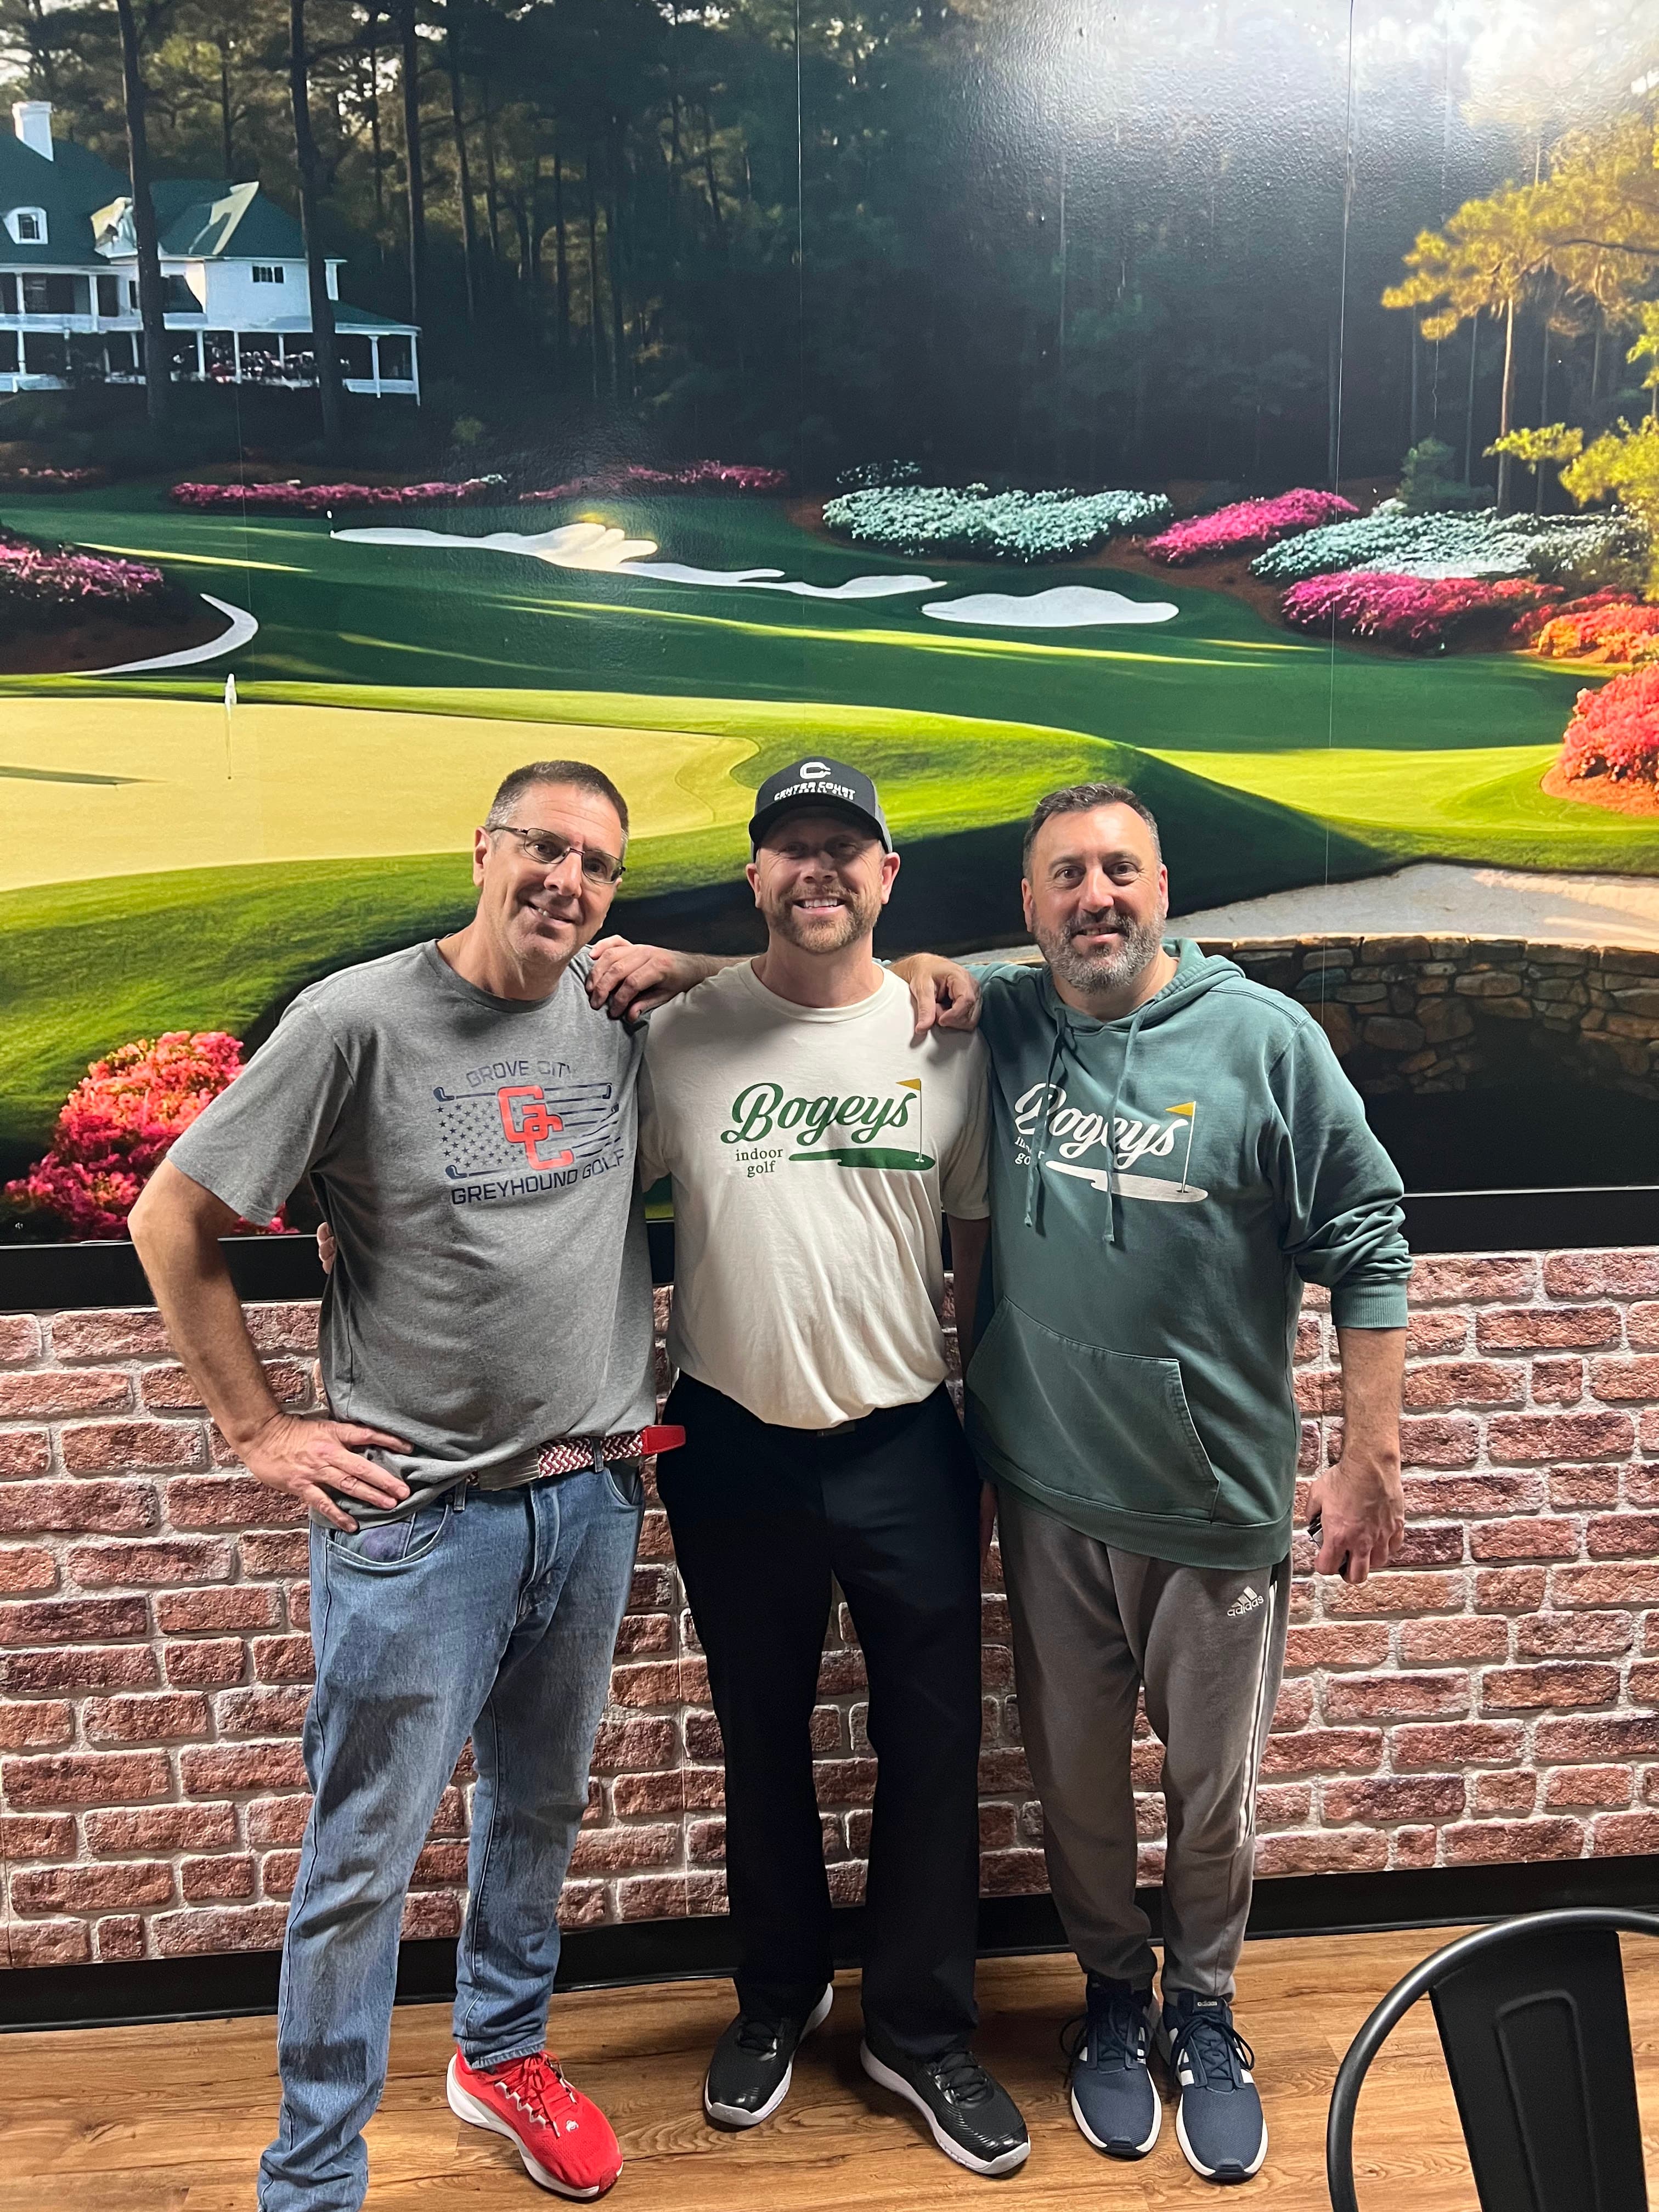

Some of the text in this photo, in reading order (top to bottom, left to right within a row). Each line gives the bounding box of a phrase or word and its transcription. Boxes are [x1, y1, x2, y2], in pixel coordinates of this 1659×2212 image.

[466, 1060, 529, 1088] GROVE
[720, 1082, 917, 1146] Bogeys
[735, 1148, 783, 1161] indoor
[452, 1148, 624, 1204] GREYHOUND GOLF
[747, 1161, 776, 1177] golf
[1227, 1595, 1264, 1616] adidas
